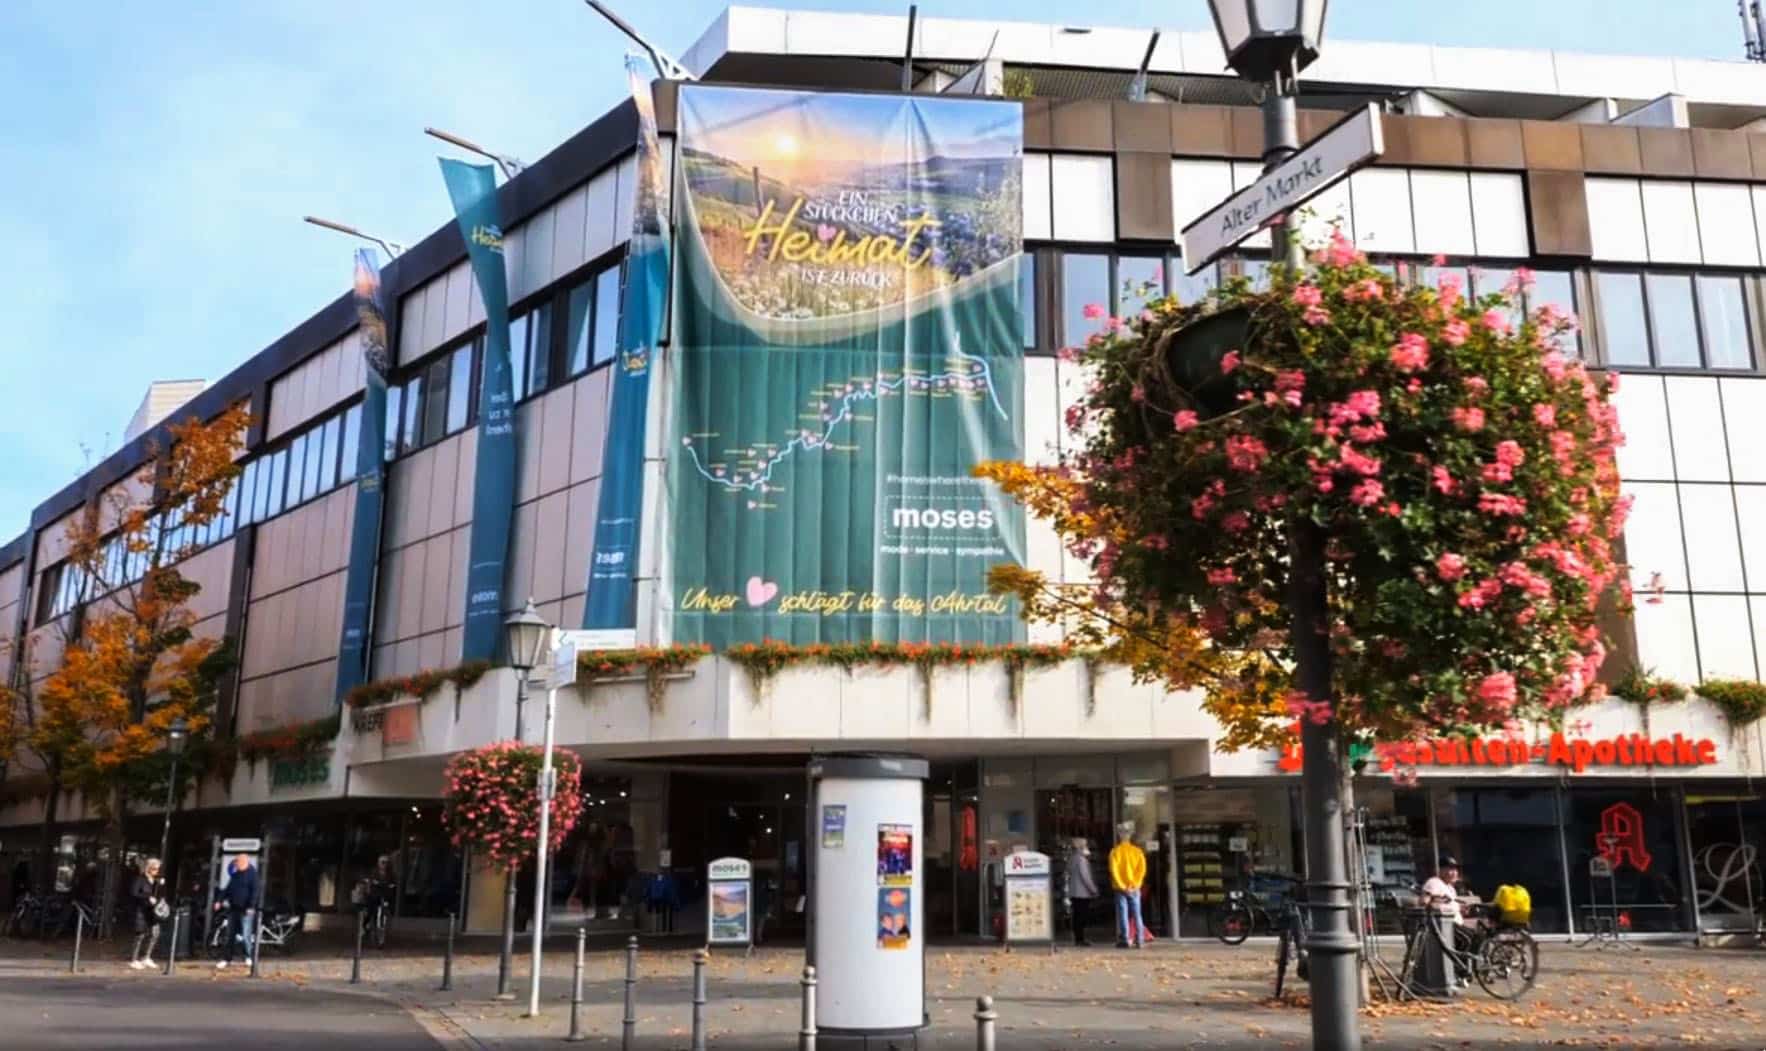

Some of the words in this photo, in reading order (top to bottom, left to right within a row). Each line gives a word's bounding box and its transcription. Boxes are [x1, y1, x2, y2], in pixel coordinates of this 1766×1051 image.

[839, 190, 868, 206] EIN
[1222, 198, 1262, 234] Alter
[1265, 158, 1323, 202] Markt
[744, 198, 942, 270] Heimat
[892, 508, 994, 529] moses
[680, 587, 739, 614] Unser
[777, 590, 855, 616] schlägt
[892, 593, 926, 616] das
